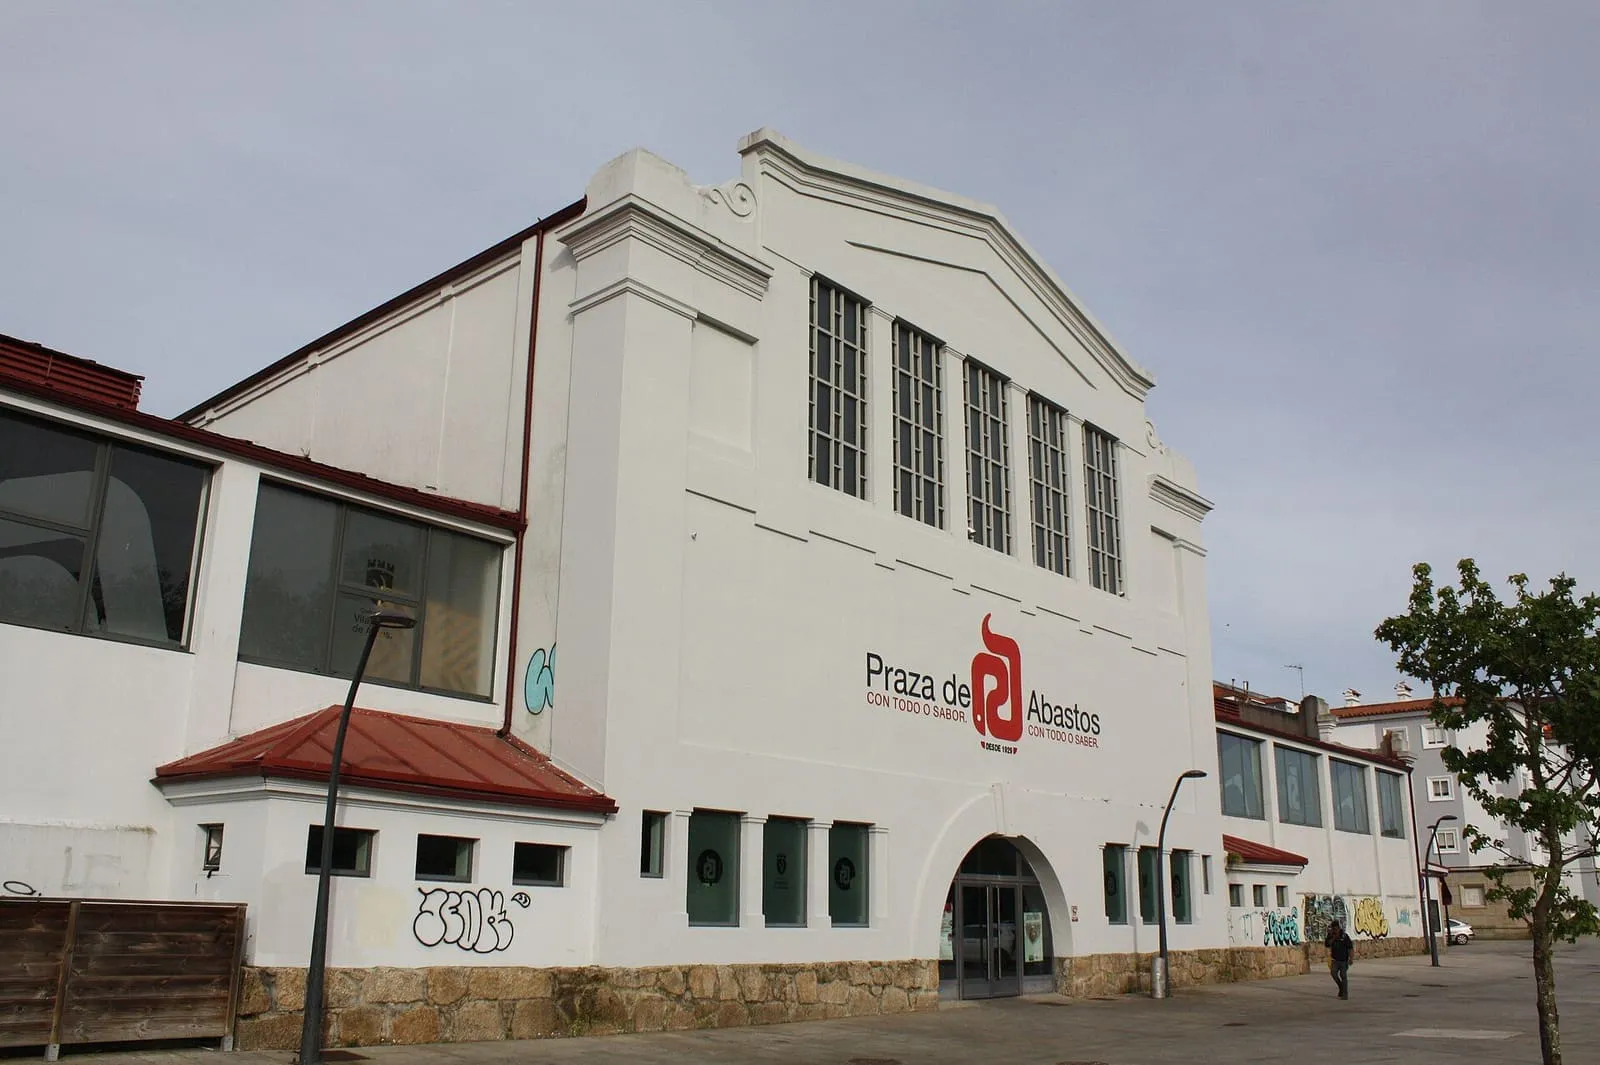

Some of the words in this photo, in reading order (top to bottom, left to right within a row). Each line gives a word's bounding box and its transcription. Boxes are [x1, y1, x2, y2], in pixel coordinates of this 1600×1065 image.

[866, 652, 936, 702] Praza
[942, 674, 971, 708] de
[1027, 690, 1101, 736] Abastos
[866, 691, 890, 708] CON
[893, 697, 921, 714] TODO
[923, 704, 931, 716] O
[933, 706, 968, 723] SABOR.
[985, 742, 1002, 753] DESDE
[1028, 724, 1045, 738] CON
[1047, 727, 1067, 742] TODO
[1067, 732, 1074, 743] O
[1075, 733, 1099, 749] SABER.
